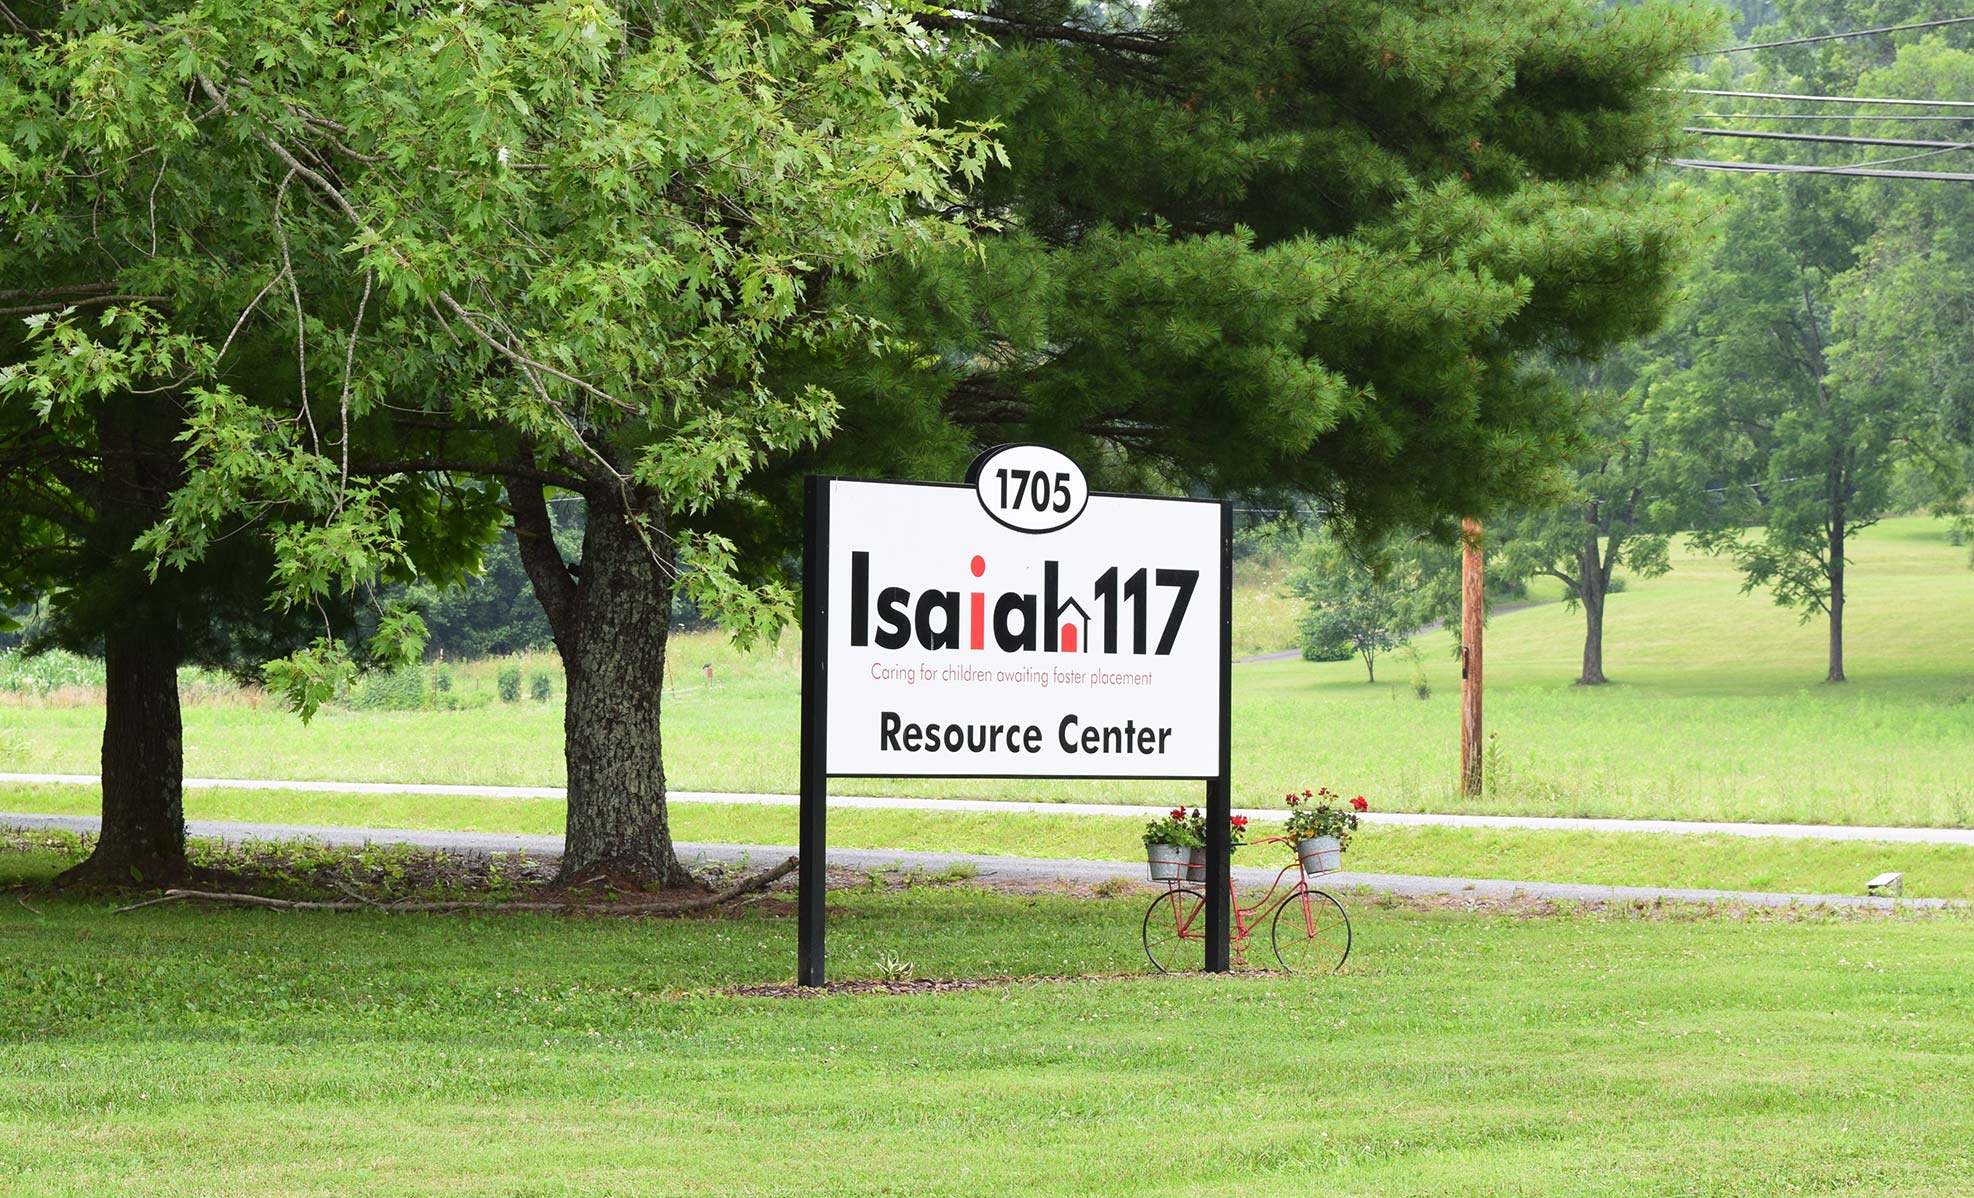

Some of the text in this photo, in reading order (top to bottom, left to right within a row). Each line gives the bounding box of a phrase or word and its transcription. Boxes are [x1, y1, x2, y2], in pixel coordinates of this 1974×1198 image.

[995, 469, 1070, 513] 1705
[871, 663, 1152, 688] Caring for children awaiting foster placement
[881, 712, 1171, 754] Resource Center
